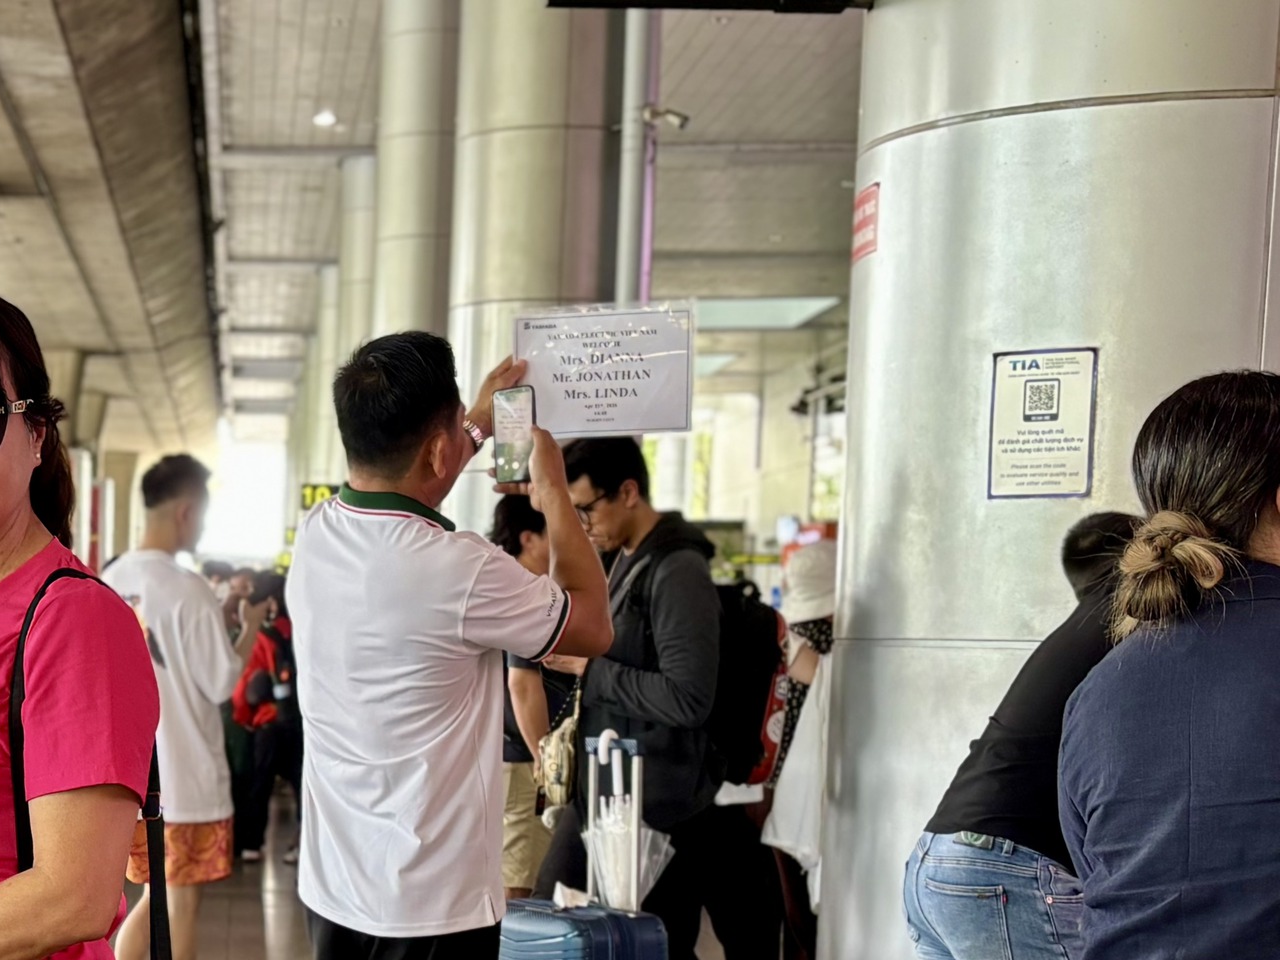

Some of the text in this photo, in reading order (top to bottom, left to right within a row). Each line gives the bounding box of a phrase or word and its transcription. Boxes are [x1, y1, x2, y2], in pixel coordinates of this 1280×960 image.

[1009, 359, 1041, 371] TIA
[552, 369, 651, 383] Mr. JONATHAN
[564, 387, 638, 400] Mrs. LINDA
